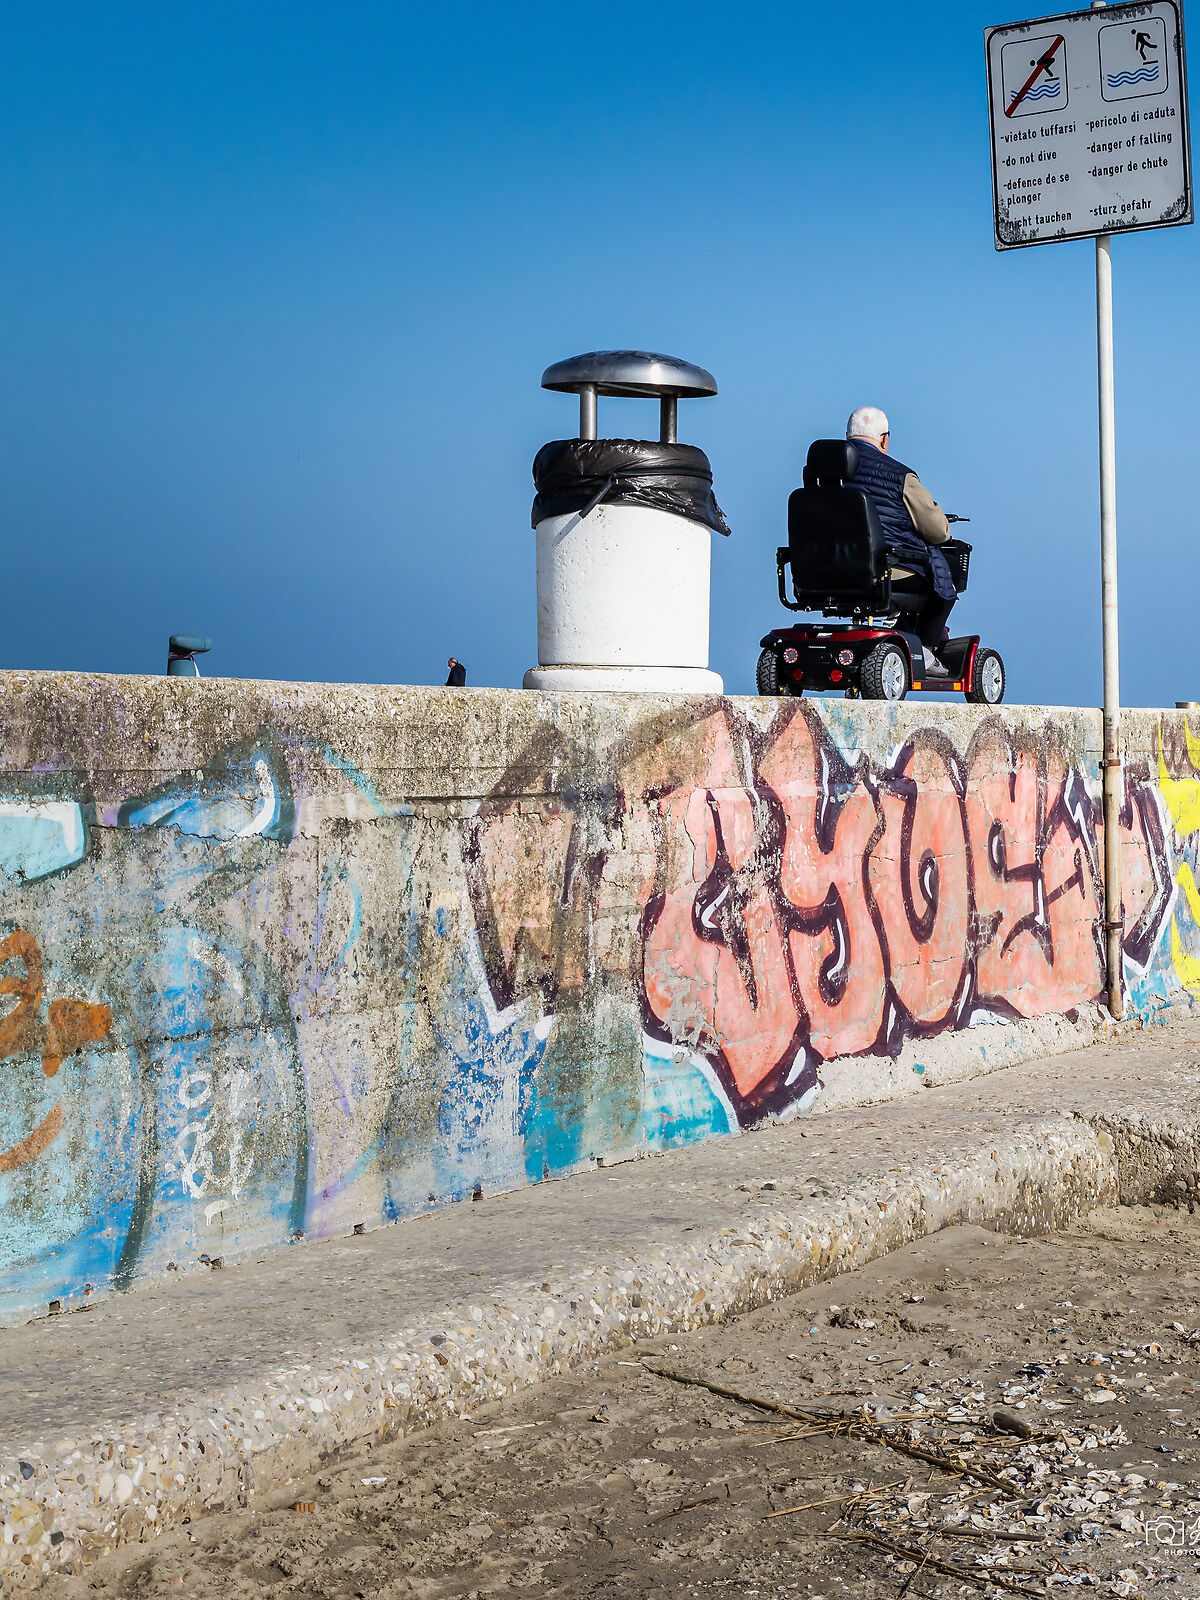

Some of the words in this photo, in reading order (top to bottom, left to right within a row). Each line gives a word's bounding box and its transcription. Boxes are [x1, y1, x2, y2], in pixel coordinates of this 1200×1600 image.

[1085, 114, 1127, 132] -pericolo
[1131, 111, 1140, 122] di
[1143, 106, 1176, 121] caduta
[1000, 129, 1037, 143] -vietato
[1040, 121, 1077, 138] tuffarsi
[1086, 140, 1123, 153] -danger
[1126, 136, 1136, 147] of
[1139, 131, 1172, 146] falling
[1001, 156, 1016, 167] -do
[1019, 152, 1035, 165] not
[1038, 150, 1057, 162] dive
[1087, 164, 1124, 177] -danger
[1127, 161, 1138, 171] de
[1142, 156, 1168, 170] chute
[1003, 177, 1042, 190] -defence
[1045, 173, 1056, 184] de
[1059, 173, 1070, 183] se
[1007, 192, 1042, 208] plonger
[1089, 204, 1117, 216] -sturz
[1120, 198, 1152, 214] gefahr
[1034, 211, 1072, 225] tauchen
